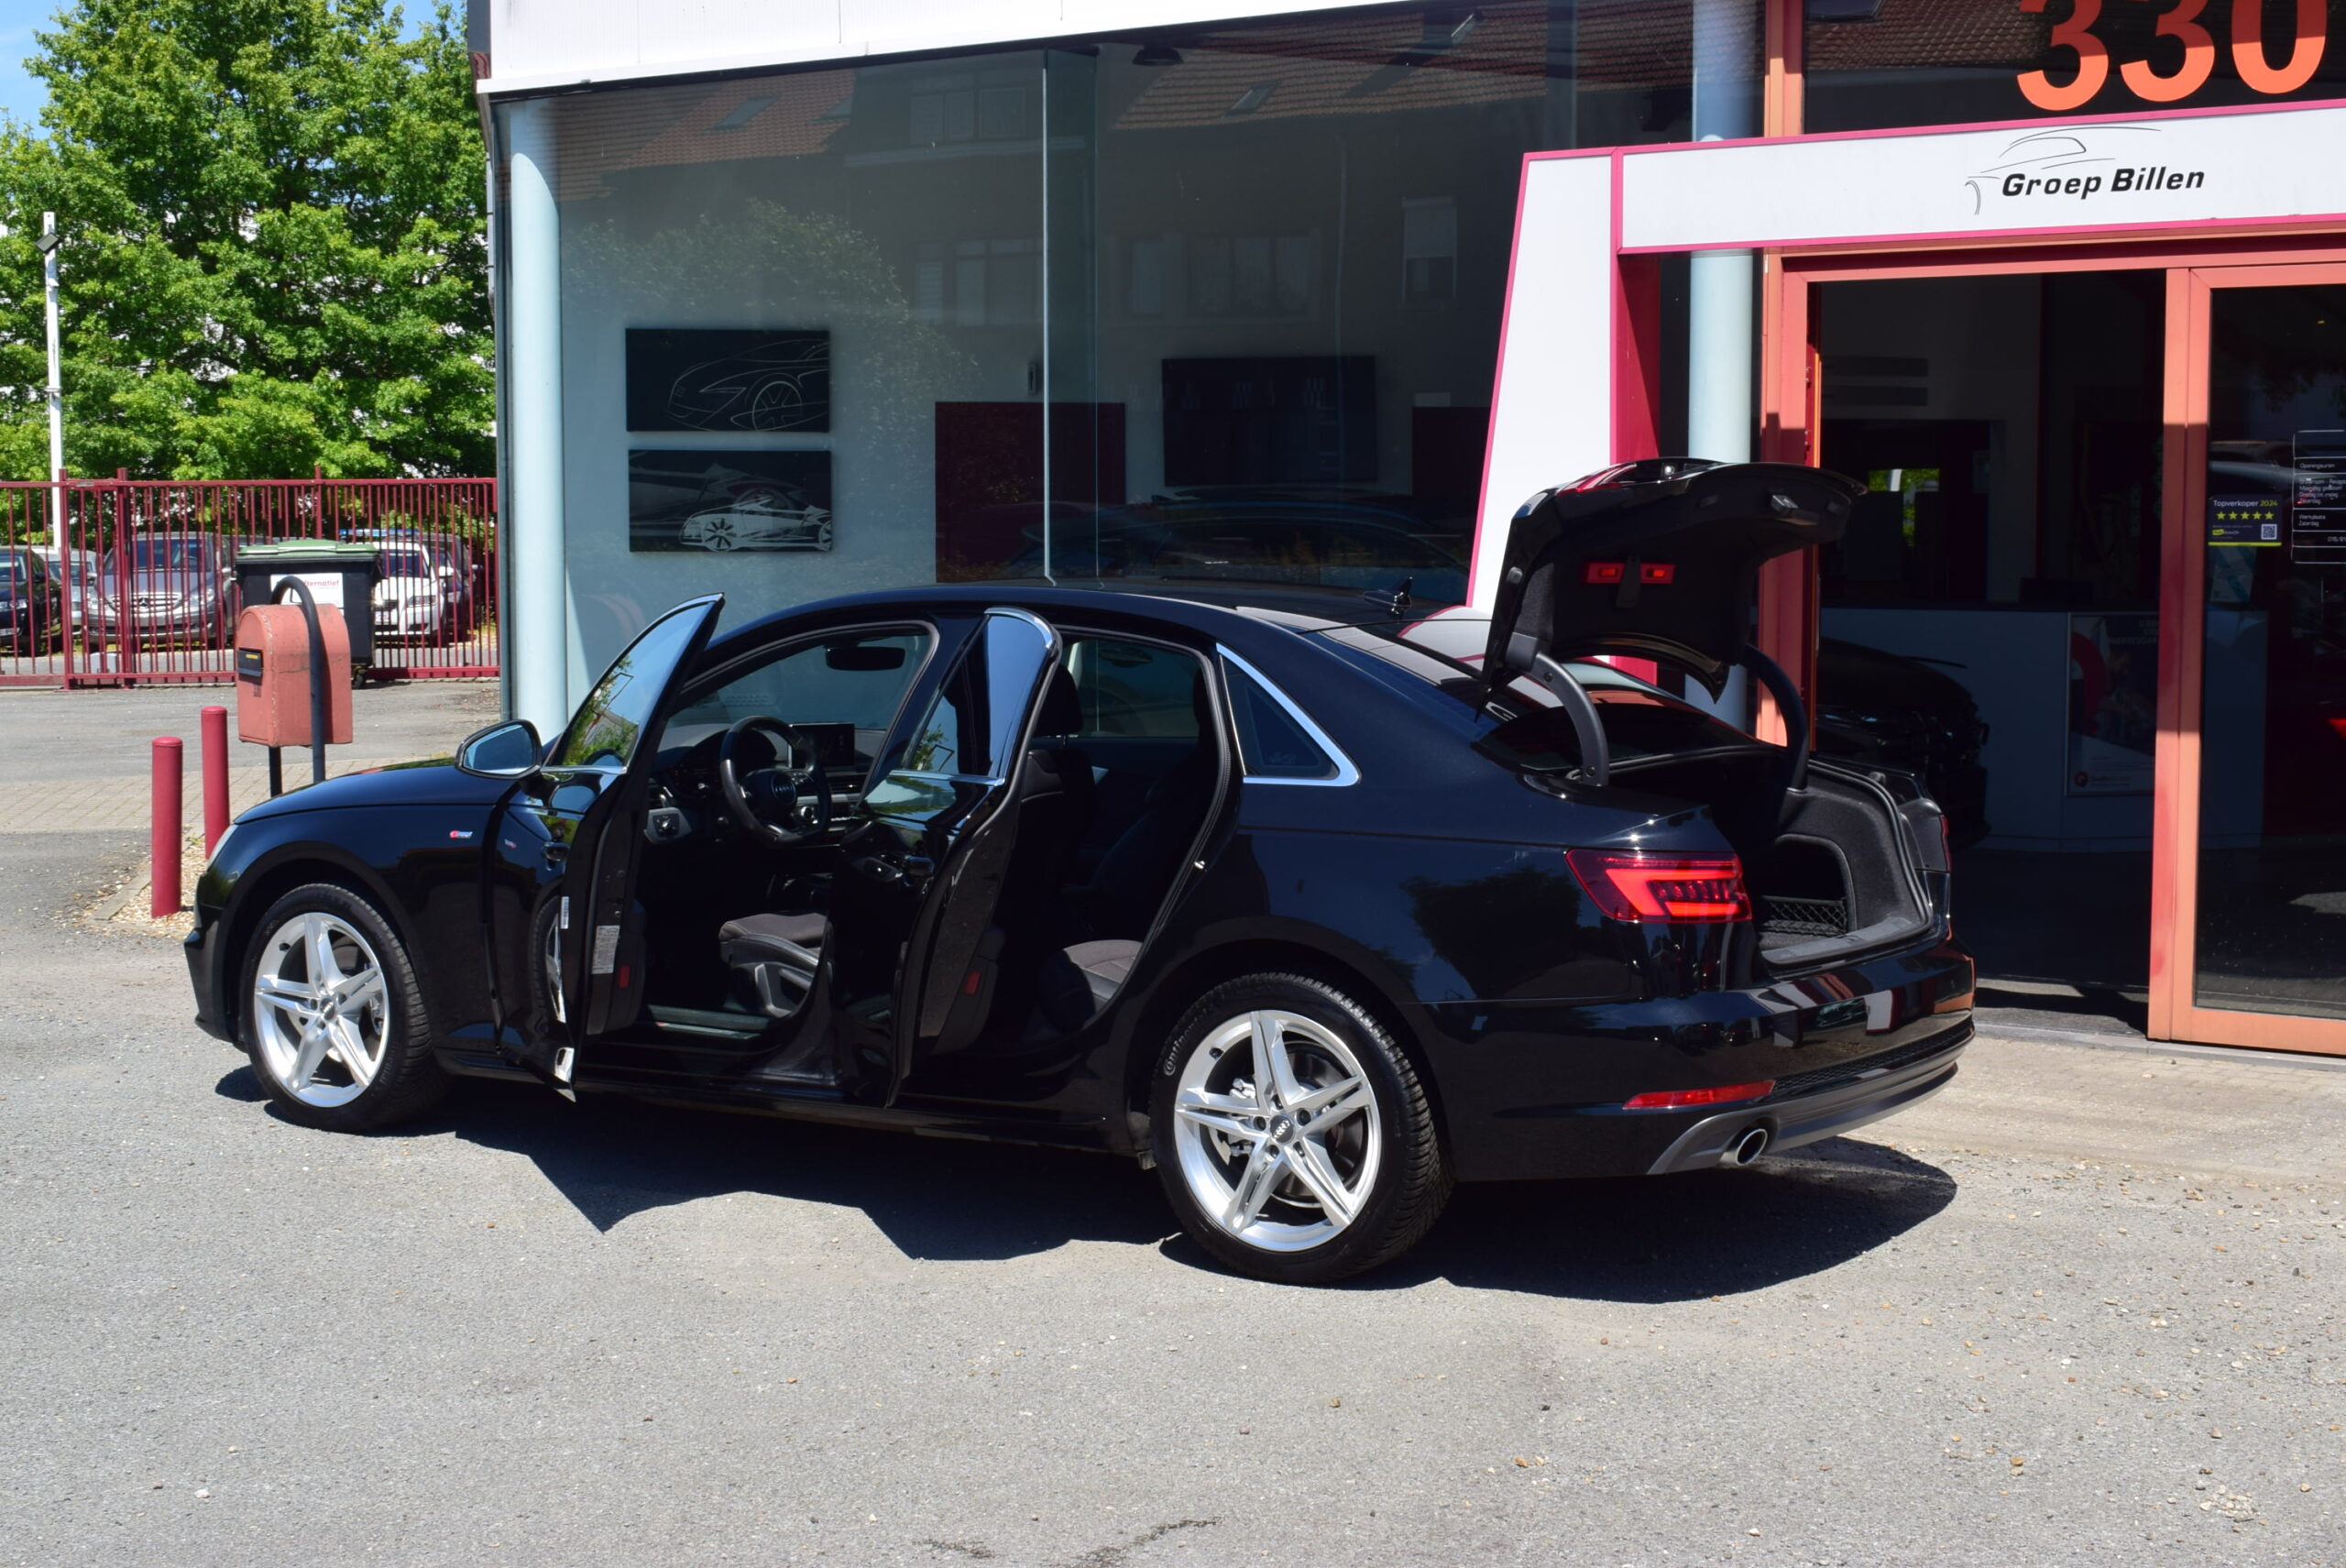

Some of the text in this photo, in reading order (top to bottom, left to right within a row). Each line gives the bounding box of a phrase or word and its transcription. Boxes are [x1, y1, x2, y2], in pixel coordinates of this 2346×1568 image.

[2016, 0, 2327, 111] 330
[2001, 166, 2205, 200] Groep Billen
